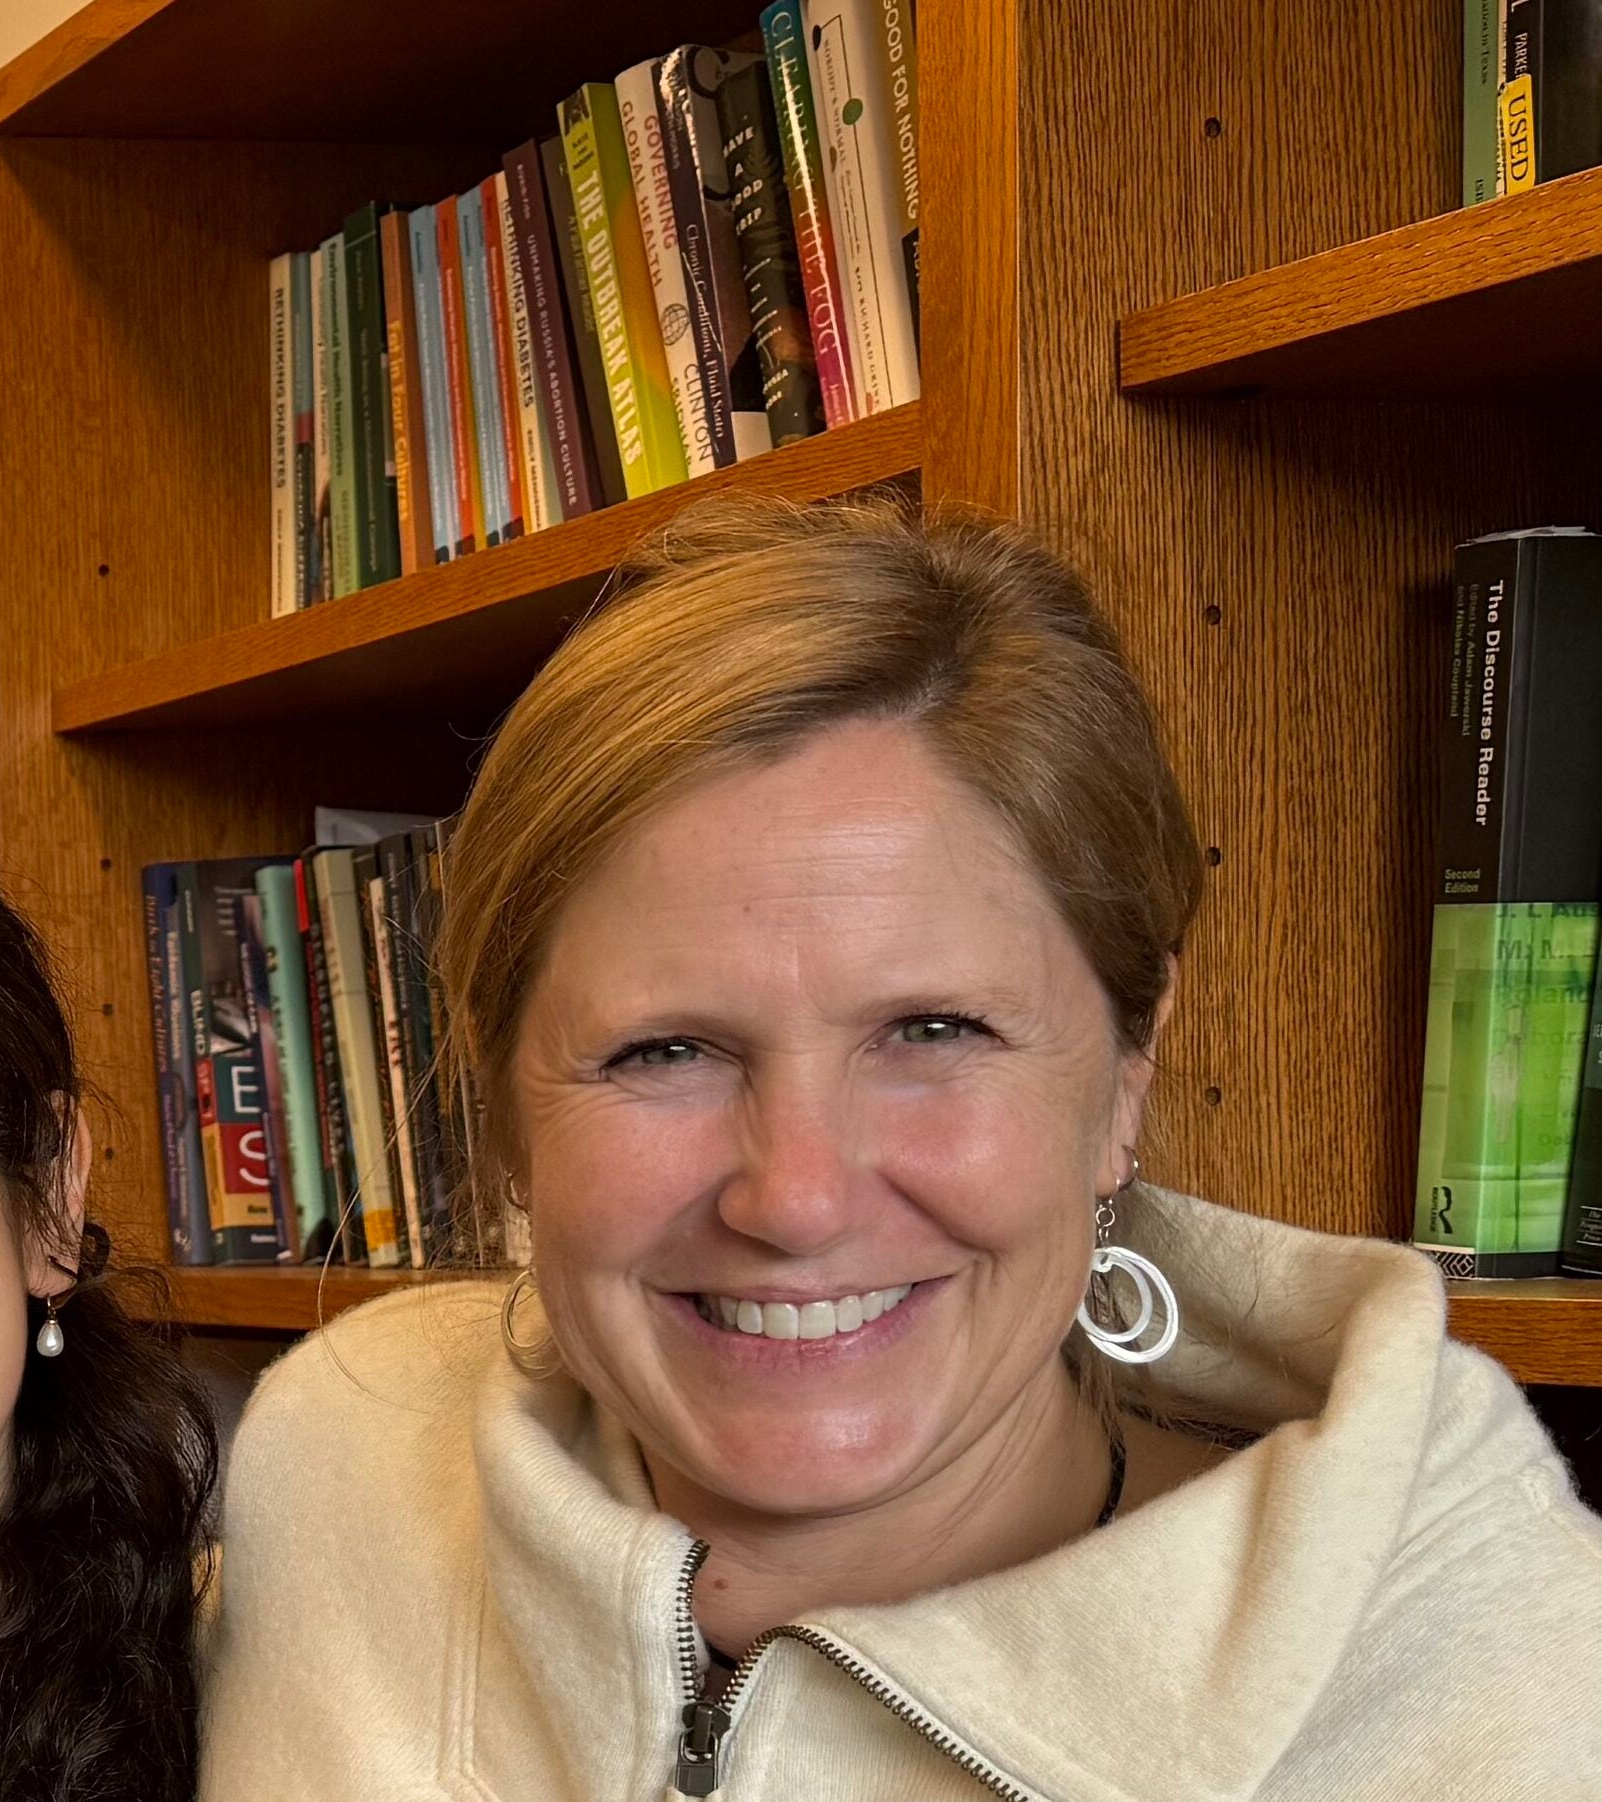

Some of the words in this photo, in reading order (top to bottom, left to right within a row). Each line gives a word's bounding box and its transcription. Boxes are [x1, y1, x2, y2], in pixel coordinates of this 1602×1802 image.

[891, 65, 910, 113] FOR
[897, 115, 919, 219] NOTHING
[1508, 92, 1529, 182] USED
[577, 170, 605, 230] THE
[621, 101, 646, 192] GLOBAL
[639, 196, 663, 287] HEALTH
[644, 115, 677, 250] GOVERNING
[685, 223, 702, 277] Chronic
[388, 320, 404, 353] Fat
[586, 228, 630, 376] OUTBREAK
[810, 283, 838, 355] FOG
[275, 288, 286, 399] RETHINKING
[333, 350, 344, 398] Health
[390, 359, 405, 379] in
[515, 315, 535, 408] DIABETES
[527, 234, 546, 308] UNMAKING
[539, 310, 558, 368] RUSSIA'S
[549, 371, 567, 440] ABORTION
[560, 444, 578, 505] CULTURE
[391, 384, 406, 430] Four
[684, 363, 713, 462] CLINTON
[705, 360, 721, 397] Fluid
[276, 402, 286, 488] DIABETES
[335, 401, 345, 476] Narratives
[612, 377, 643, 466] ATLAS
[711, 399, 726, 438] States
[395, 437, 410, 521] Cultures
[1453, 609, 1465, 656] Nikolas
[1487, 579, 1505, 623] The
[1449, 658, 1461, 717] Coupland
[1465, 640, 1476, 678] Adam
[1480, 629, 1502, 741] Discourse
[1461, 680, 1474, 737] Jaworski
[1475, 746, 1495, 827] Reader
[1444, 868, 1481, 880] Second
[1444, 882, 1479, 894] Edition
[153, 1004, 168, 1073] Cultures
